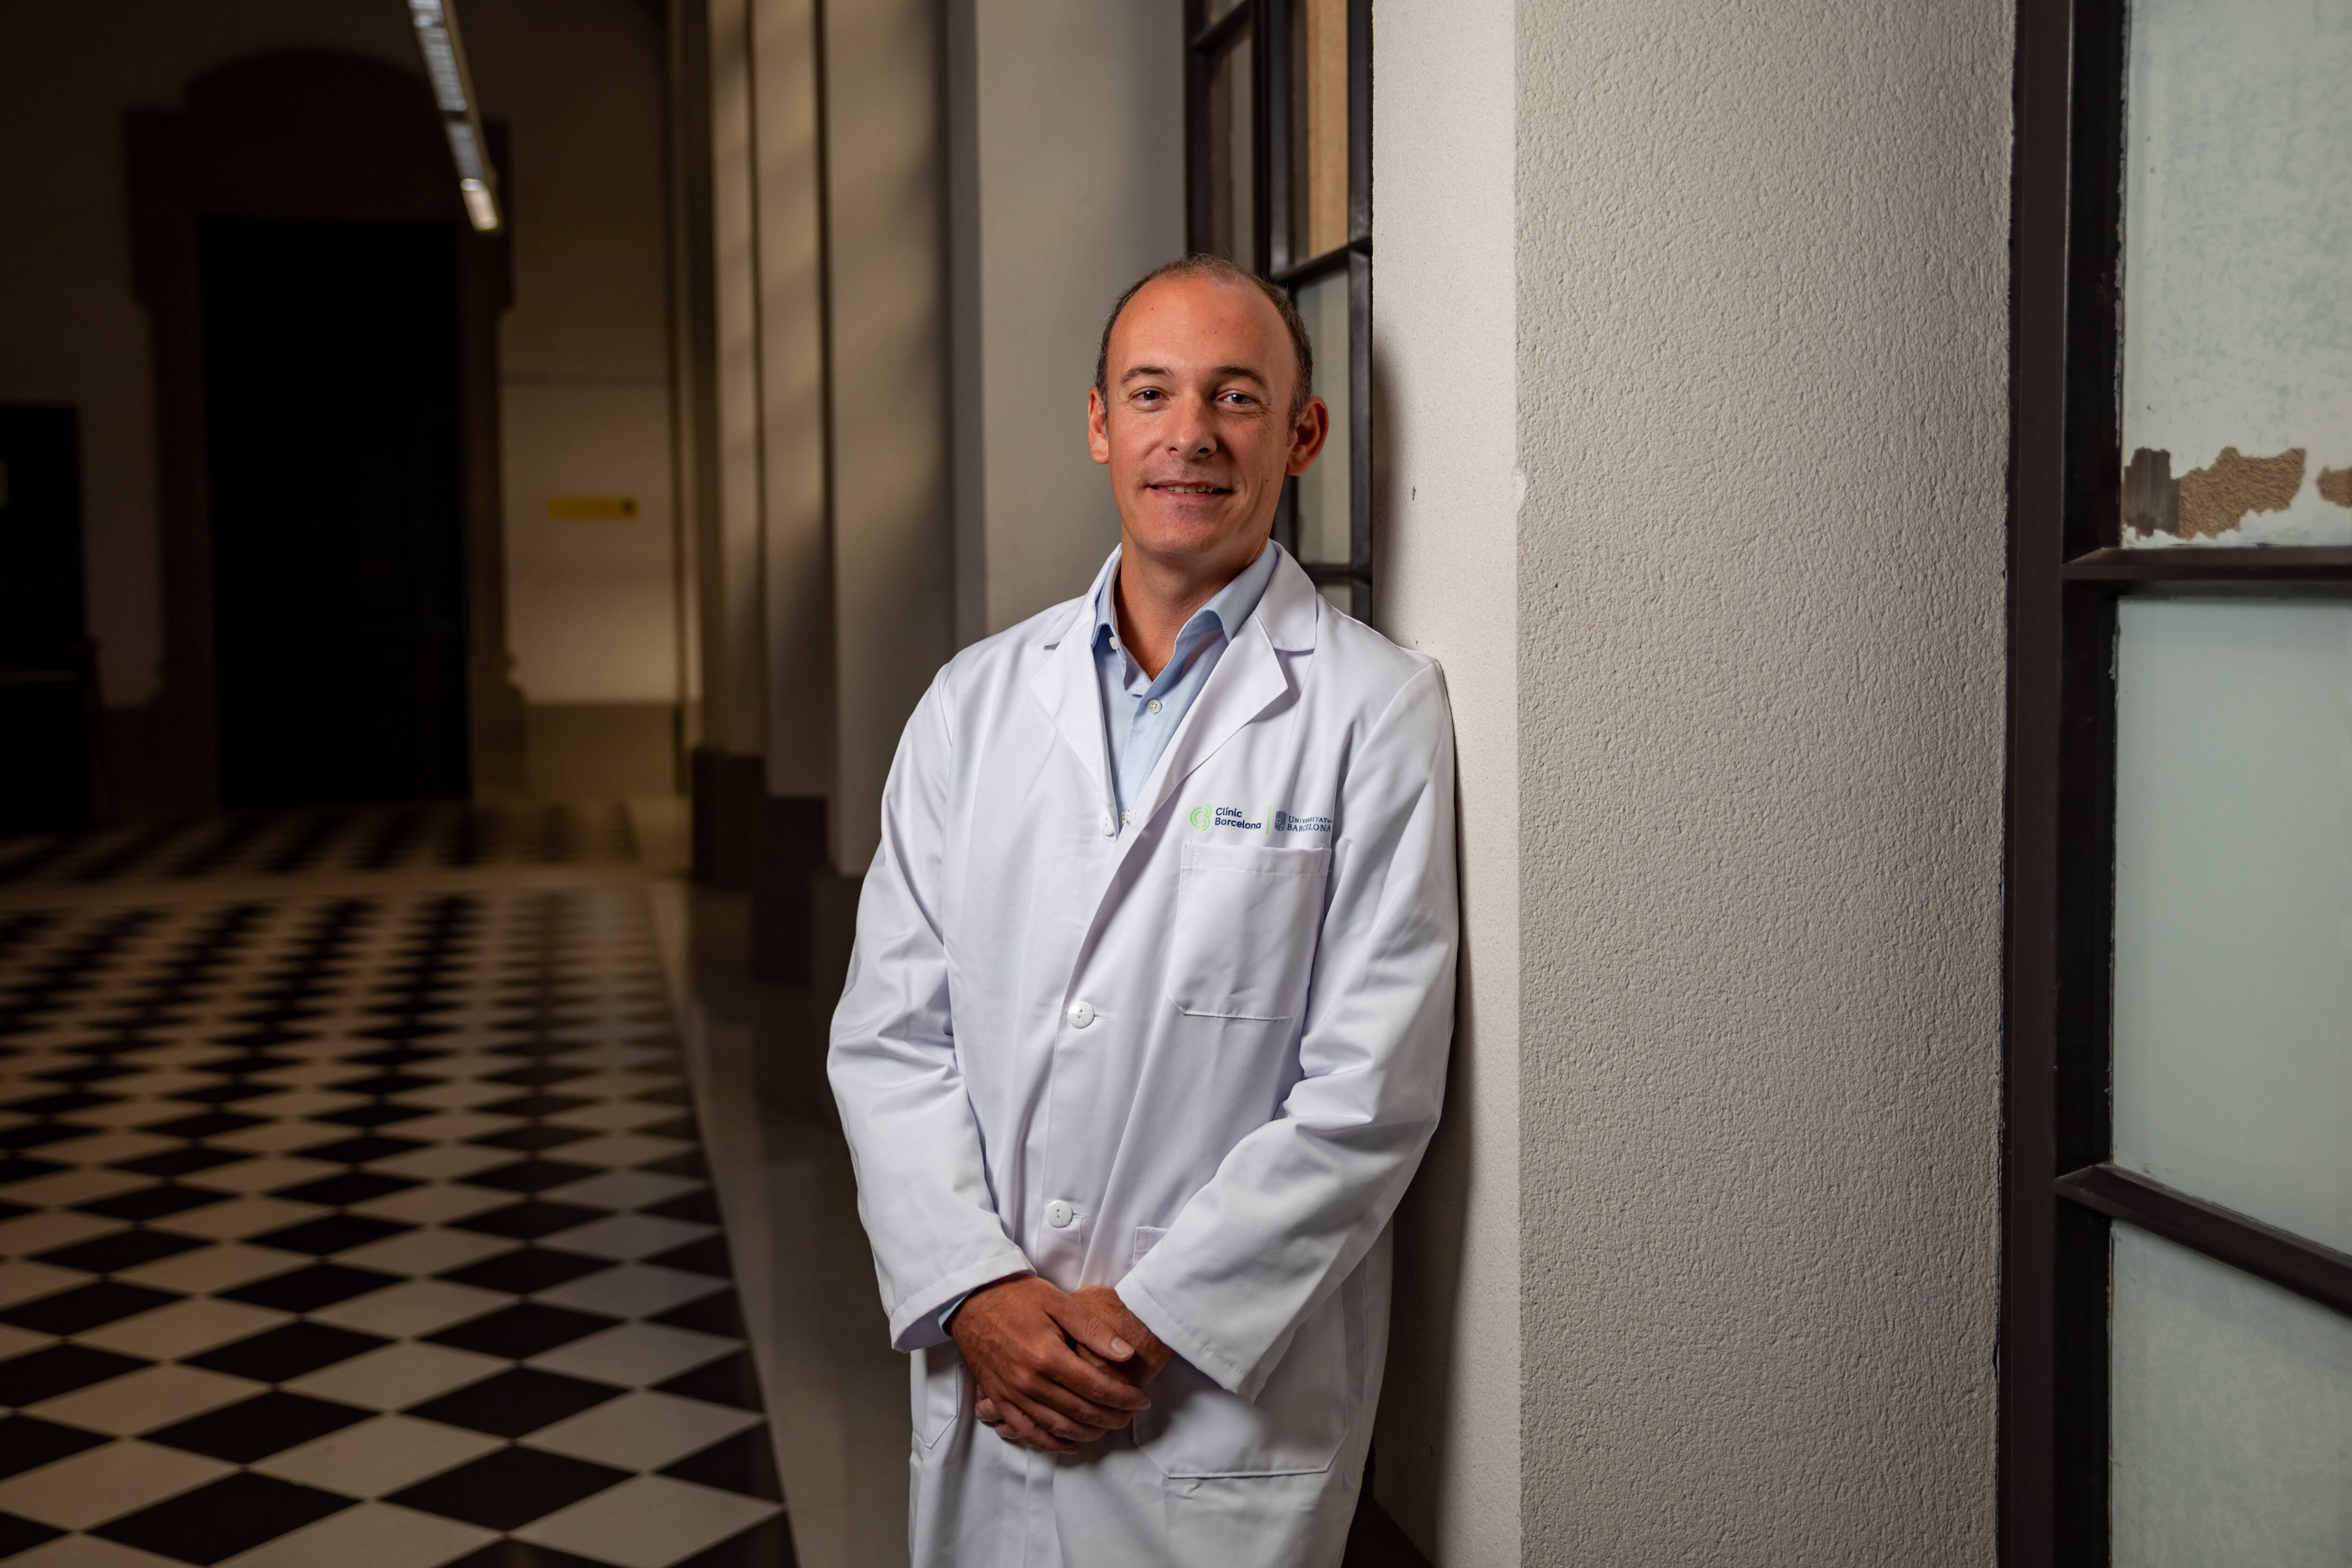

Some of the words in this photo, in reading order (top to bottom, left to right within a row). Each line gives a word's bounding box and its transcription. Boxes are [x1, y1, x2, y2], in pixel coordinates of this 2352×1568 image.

[1216, 807, 1242, 818] Clínic
[1215, 817, 1261, 829] Barcelona
[1287, 823, 1331, 832] BARCELONA
